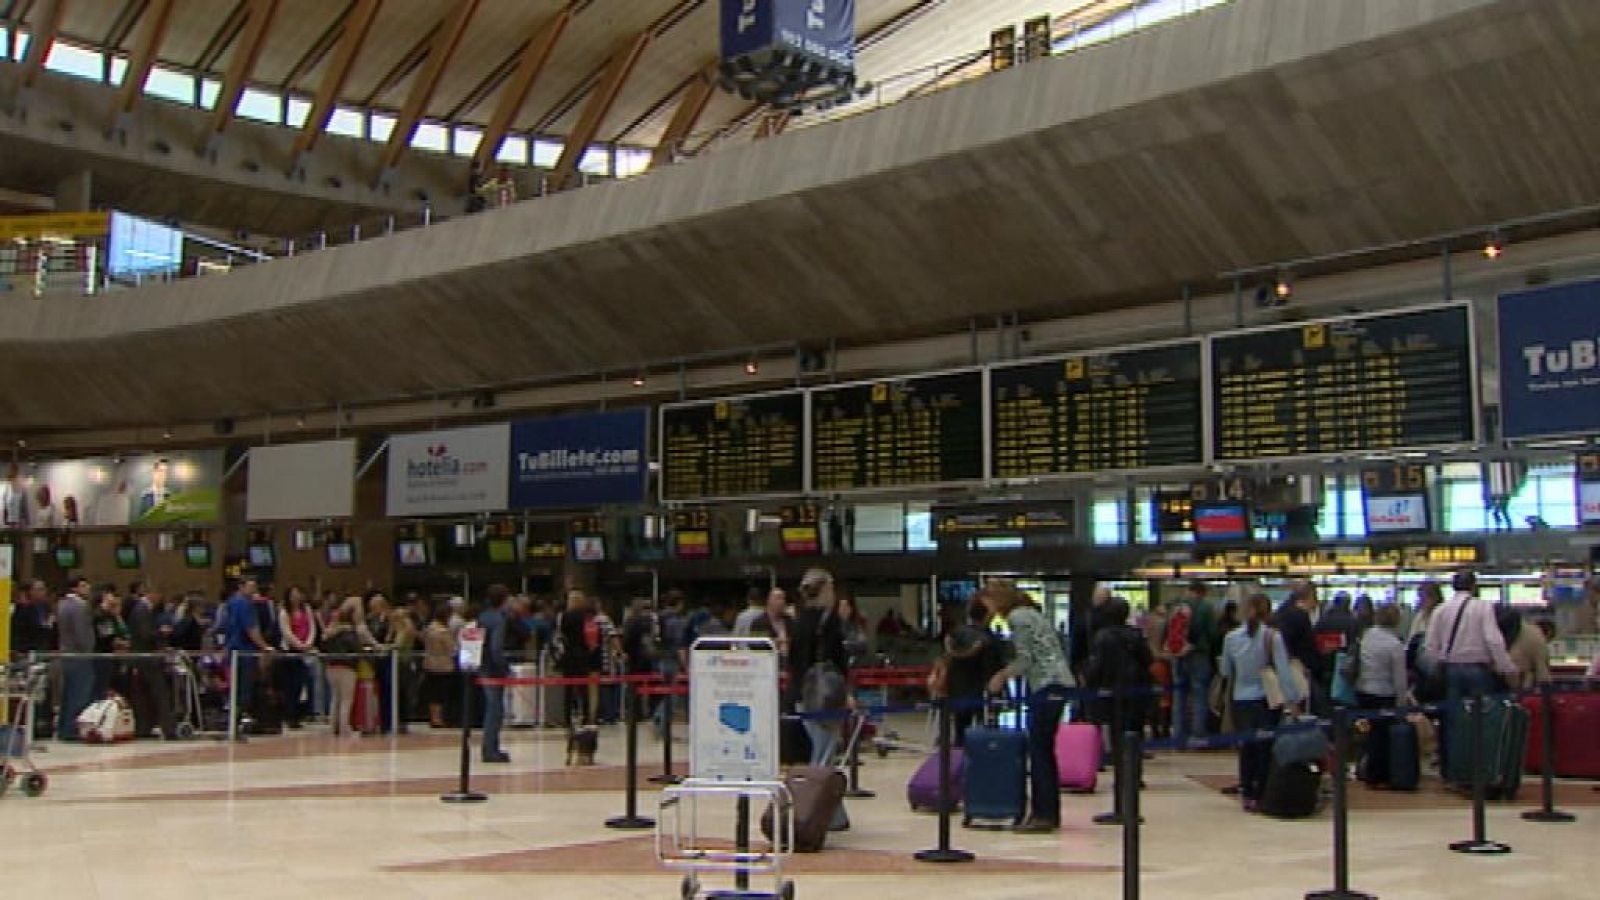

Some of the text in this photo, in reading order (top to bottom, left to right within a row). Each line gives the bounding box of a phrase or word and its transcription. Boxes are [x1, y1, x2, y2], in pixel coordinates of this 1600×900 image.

[1523, 337, 1600, 376] TuB
[518, 448, 640, 471] TuBillete.com
[1219, 477, 1242, 499] 14
[1393, 464, 1422, 489] 15
